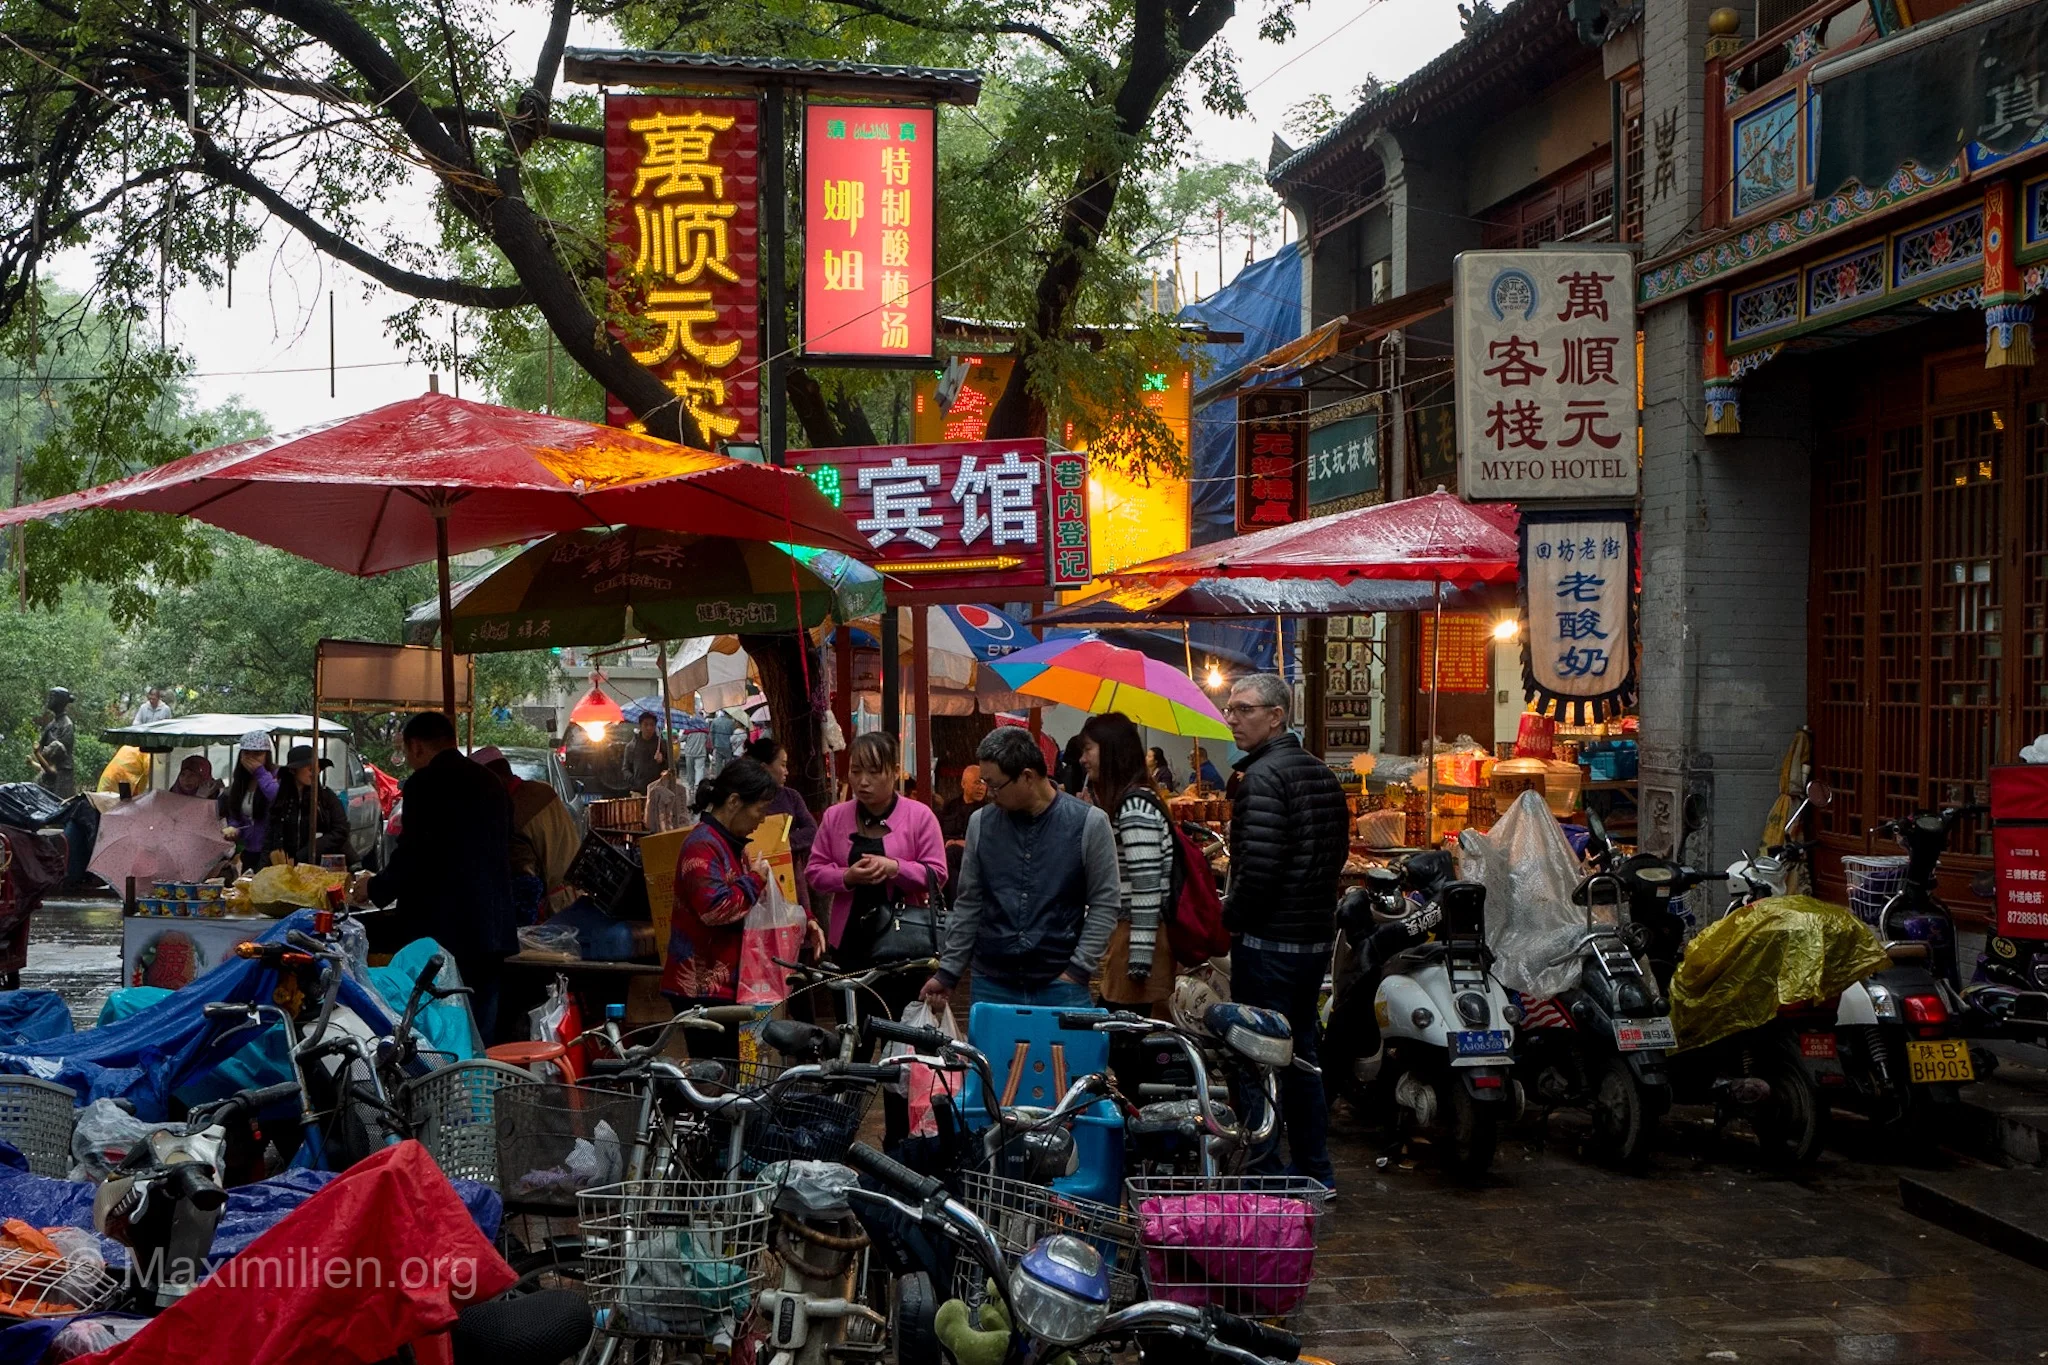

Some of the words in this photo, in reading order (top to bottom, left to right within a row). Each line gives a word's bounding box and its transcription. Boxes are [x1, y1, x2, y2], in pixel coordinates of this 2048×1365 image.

[823, 179, 865, 292] 娜姐
[880, 146, 912, 350] 特制酸梅汤
[856, 451, 1042, 550] 宾馆
[1251, 433, 1294, 523] 无糖糕点
[1481, 460, 1545, 480] MYFO
[1551, 458, 1627, 479] HOTEL
[1055, 461, 1088, 578] 巷内登记
[1535, 536, 1622, 563] 回坊老街
[1555, 570, 1609, 678] 老酸奶
[1914, 1061, 1971, 1080] BH903
